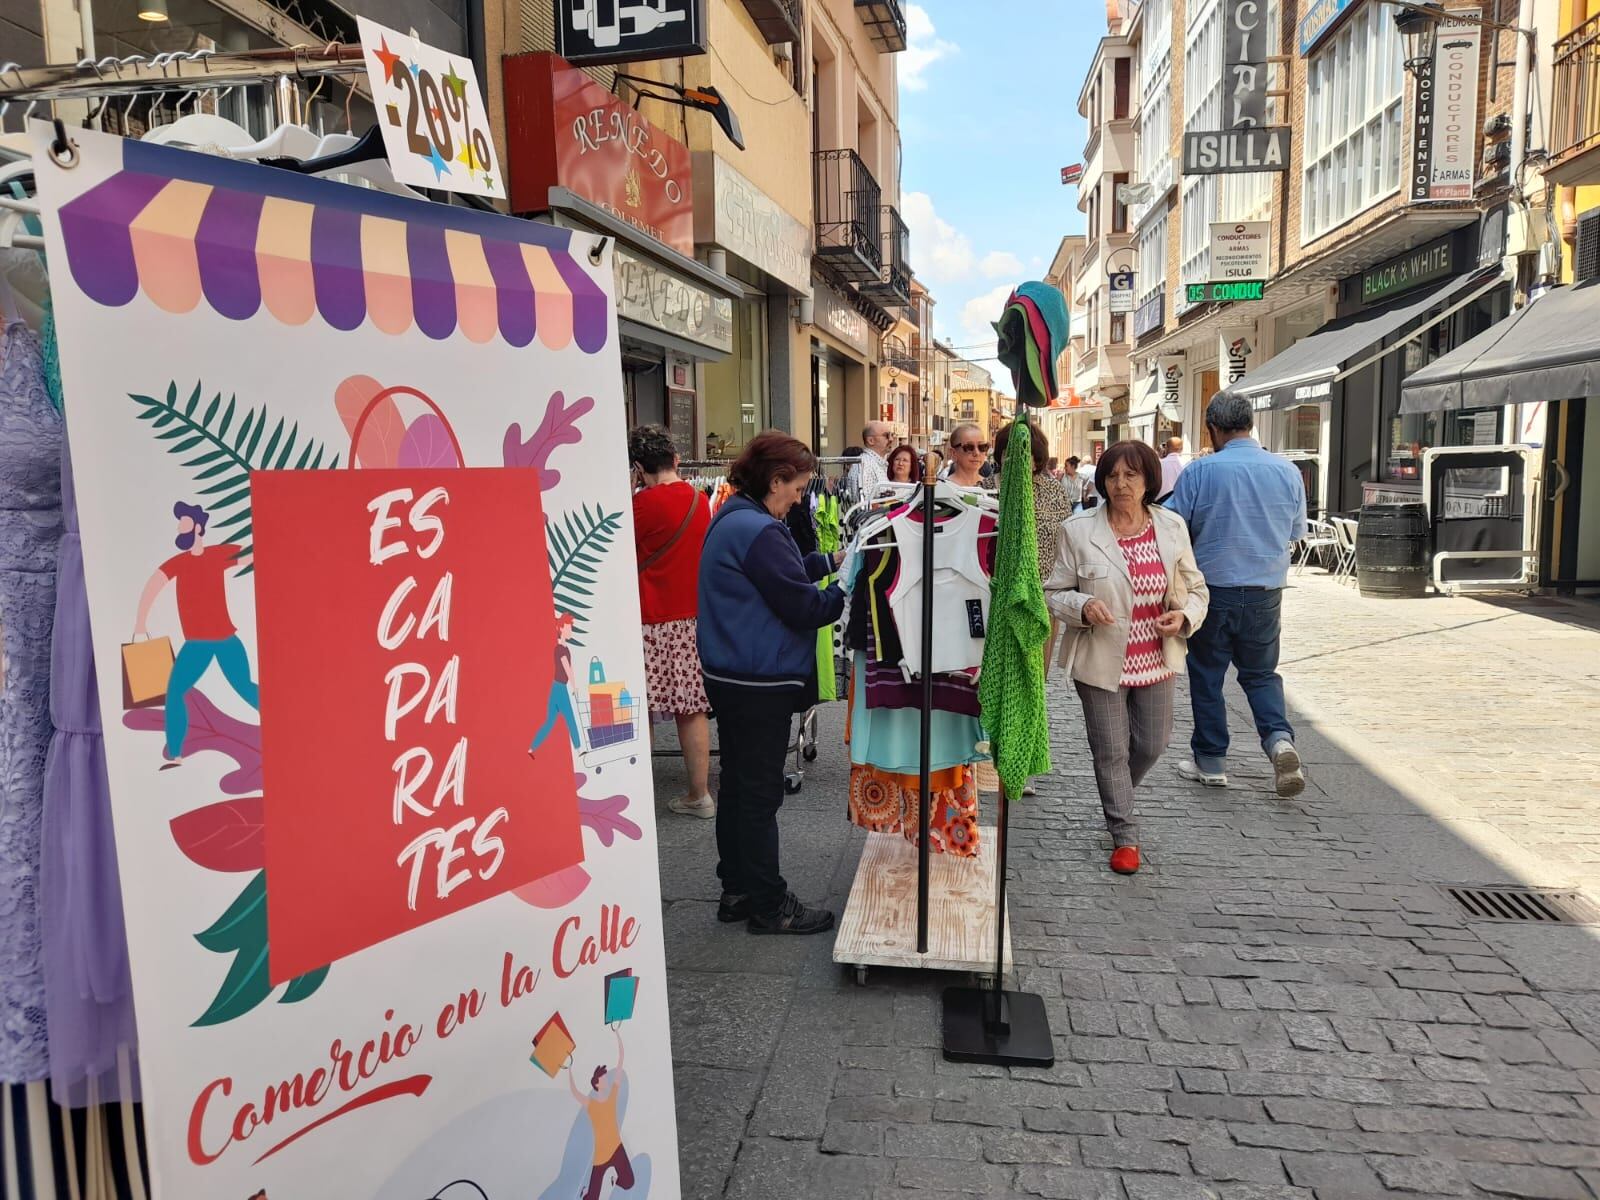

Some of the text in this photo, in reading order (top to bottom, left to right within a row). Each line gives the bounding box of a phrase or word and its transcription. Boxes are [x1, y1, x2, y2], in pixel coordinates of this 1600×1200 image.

[386, 60, 491, 172] -20%
[1446, 52, 1464, 162] CONDUCTORES
[573, 109, 681, 203] RENEDO
[1190, 132, 1282, 168] ISILLA
[1440, 169, 1470, 180] ARMAS
[1217, 233, 1261, 241] CONDUCTORES
[1225, 268, 1252, 277] ISILLA
[1365, 265, 1397, 295] BLACK
[1400, 261, 1407, 281] &
[1410, 244, 1448, 276] WHITE
[1114, 275, 1129, 290] G
[367, 487, 450, 566] ES
[377, 571, 453, 650] CA
[384, 654, 460, 741] PA
[392, 736, 468, 825] RA
[397, 807, 509, 911] TES
[187, 904, 641, 1166] Comercio en la Calle
